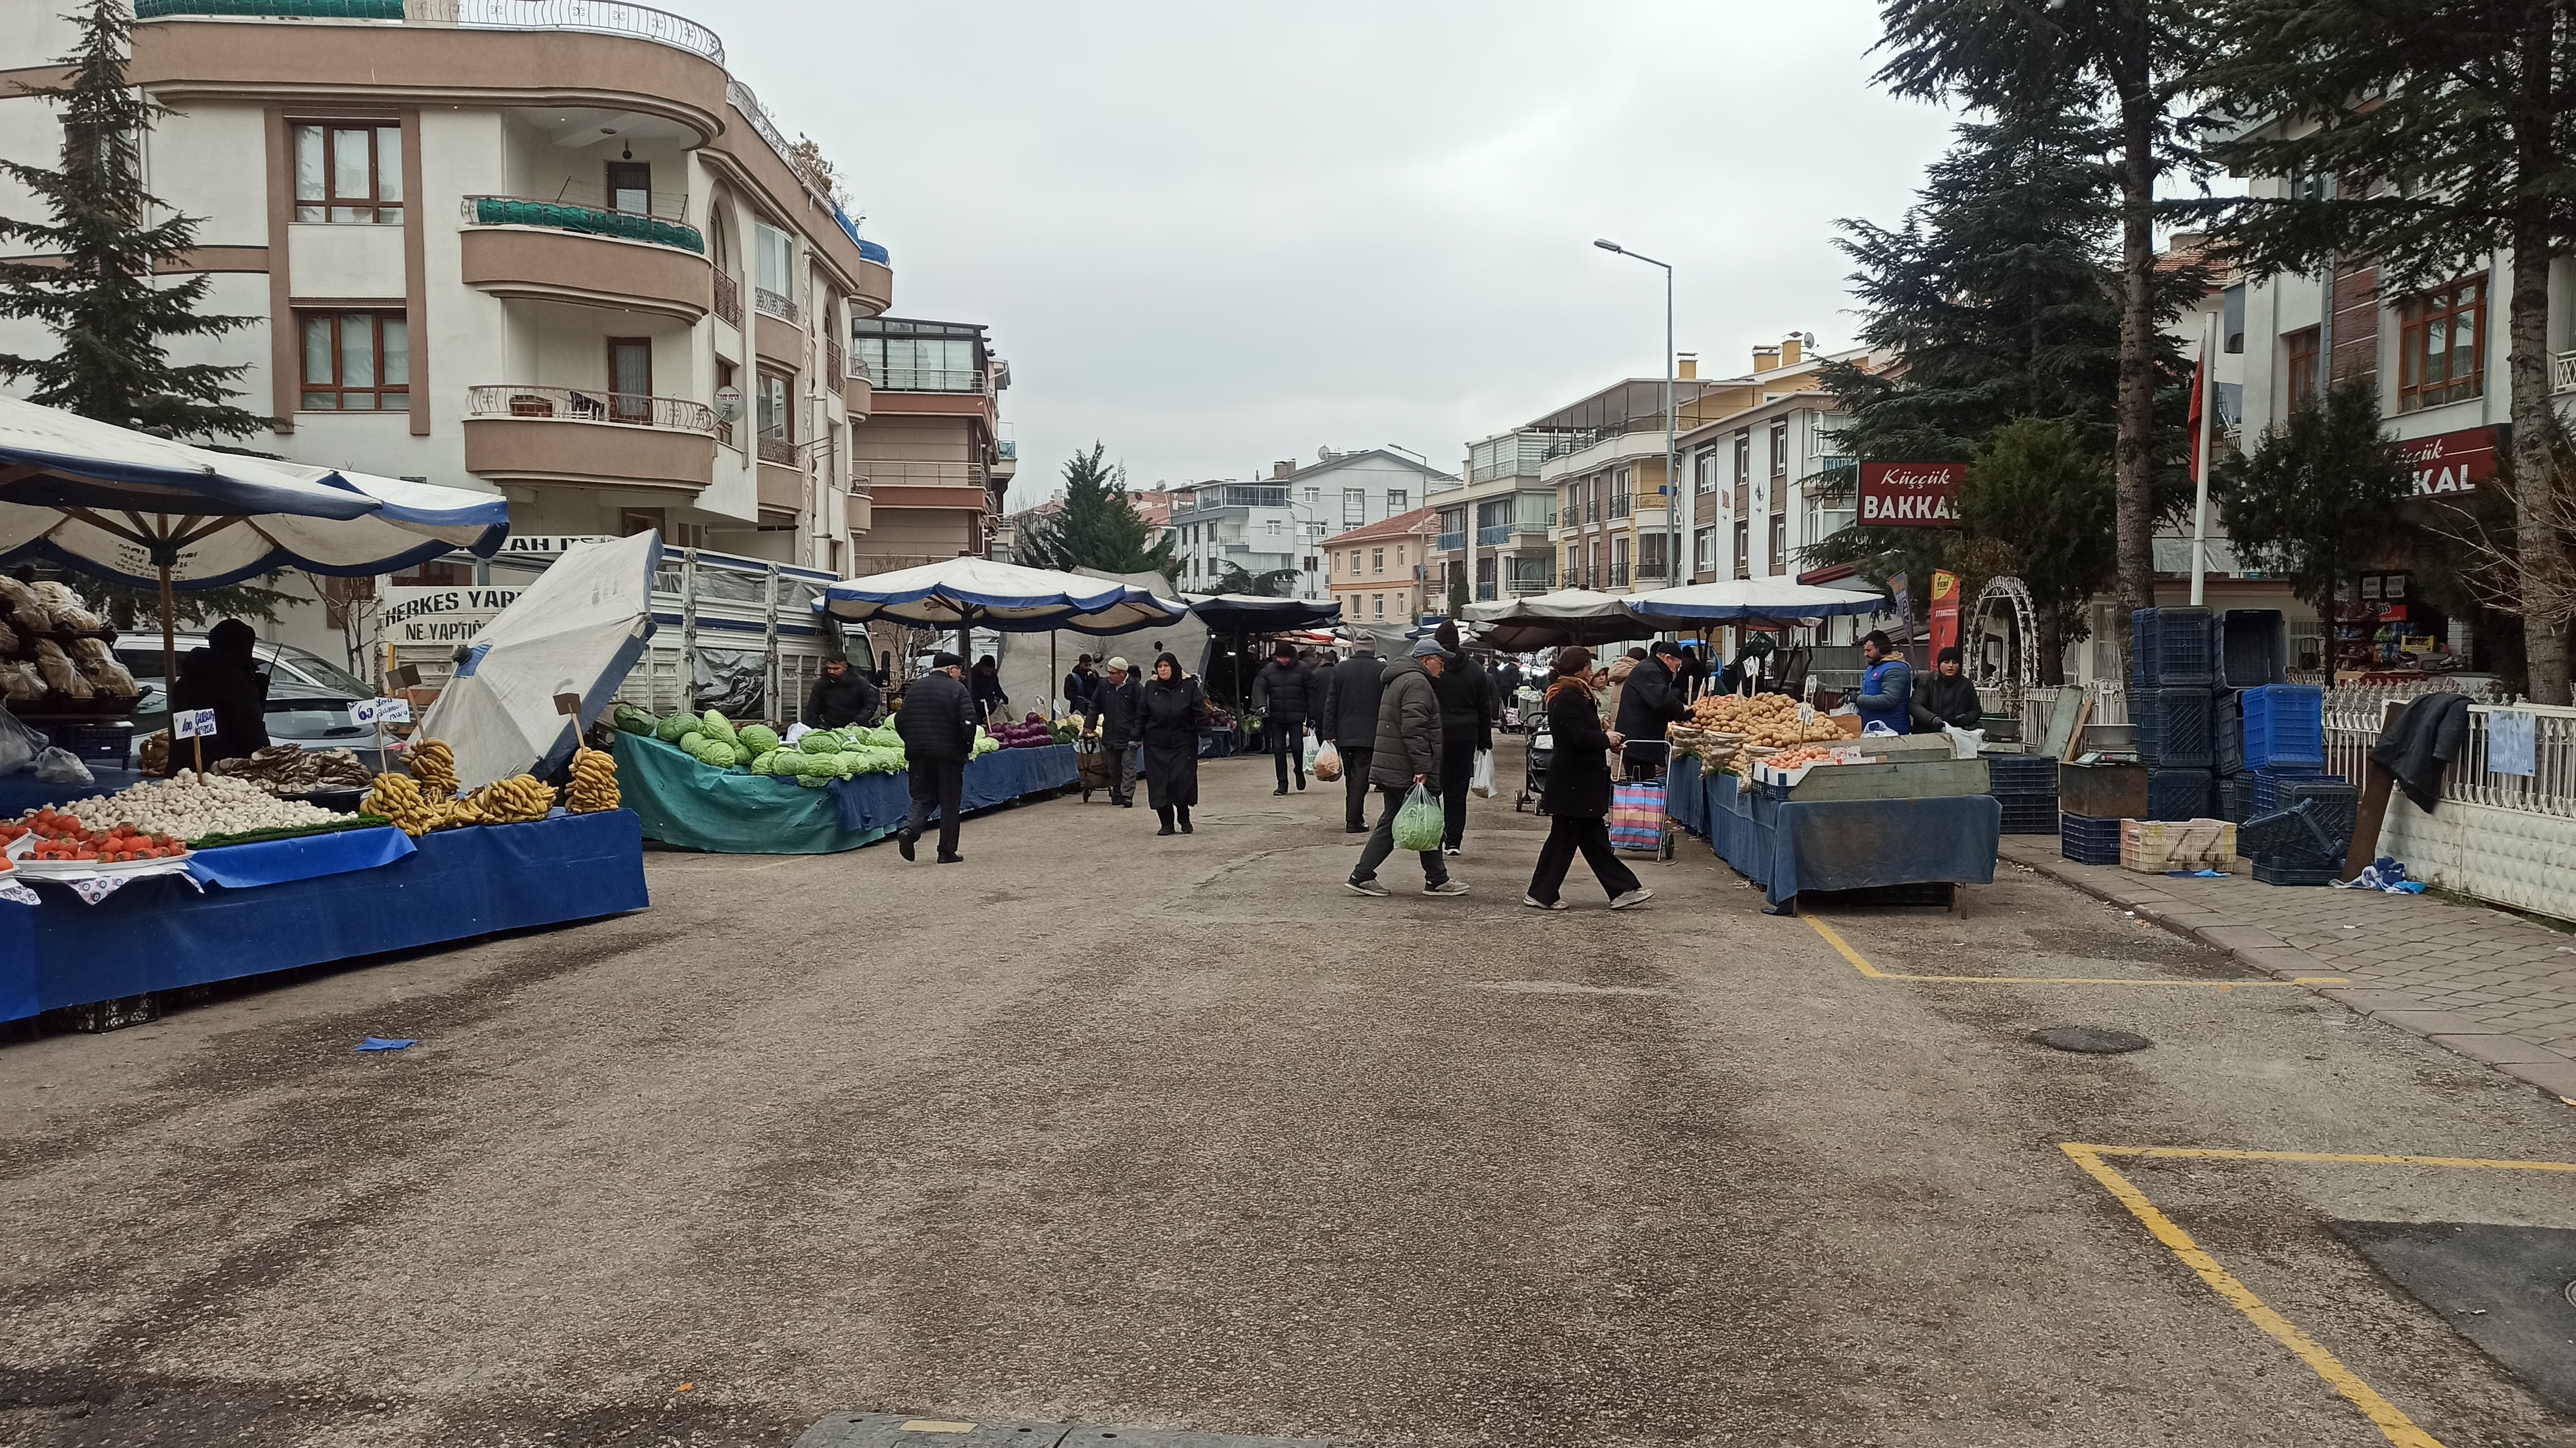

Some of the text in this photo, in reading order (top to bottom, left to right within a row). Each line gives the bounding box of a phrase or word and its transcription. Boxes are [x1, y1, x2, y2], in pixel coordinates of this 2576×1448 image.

[1881, 468, 1950, 489] Küççük
[386, 591, 522, 628] HERKES YAR
[406, 623, 423, 640] NE
[182, 718, 193, 732] 100
